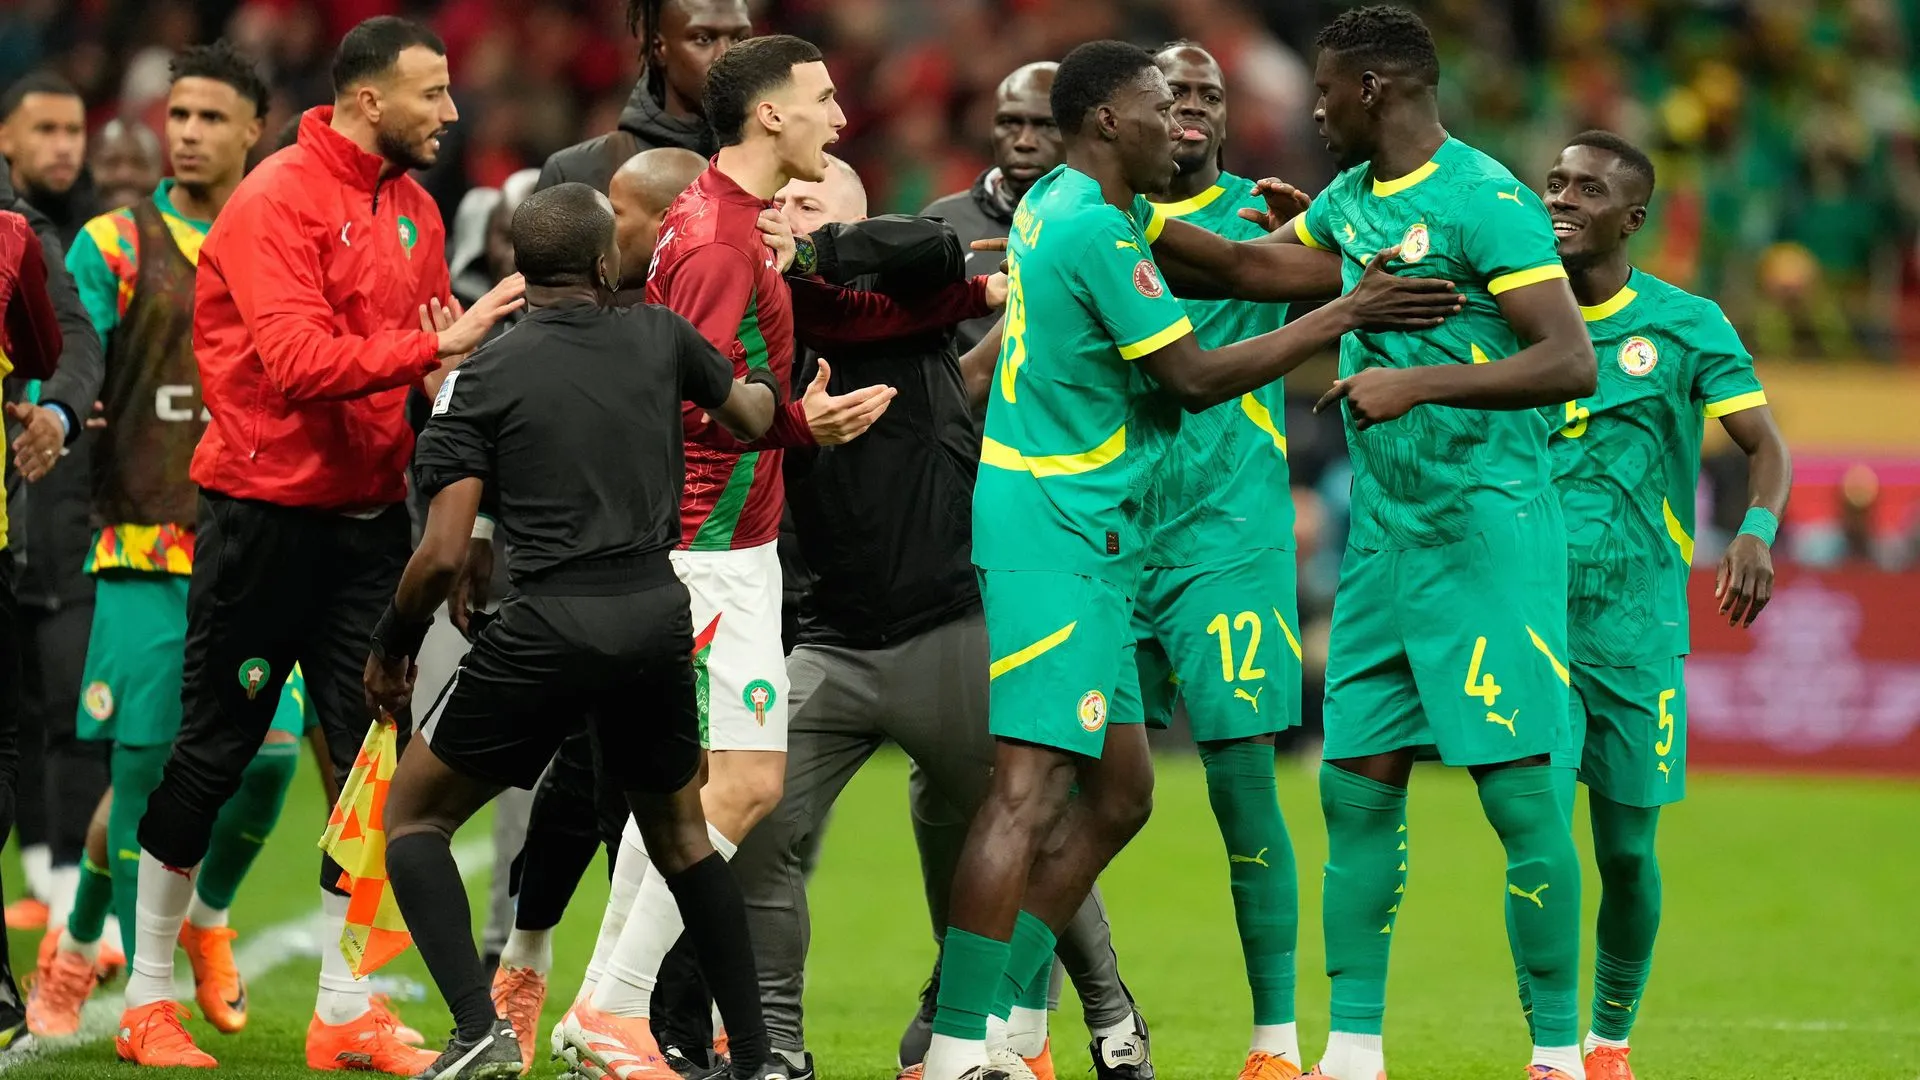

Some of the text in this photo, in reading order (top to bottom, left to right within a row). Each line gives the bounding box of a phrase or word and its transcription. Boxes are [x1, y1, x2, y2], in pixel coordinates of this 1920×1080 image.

[1206, 610, 1266, 683] 12
[1464, 636, 1502, 707] 4
[1655, 688, 1676, 756] 5
[1111, 1049, 1132, 1058] PUMA
